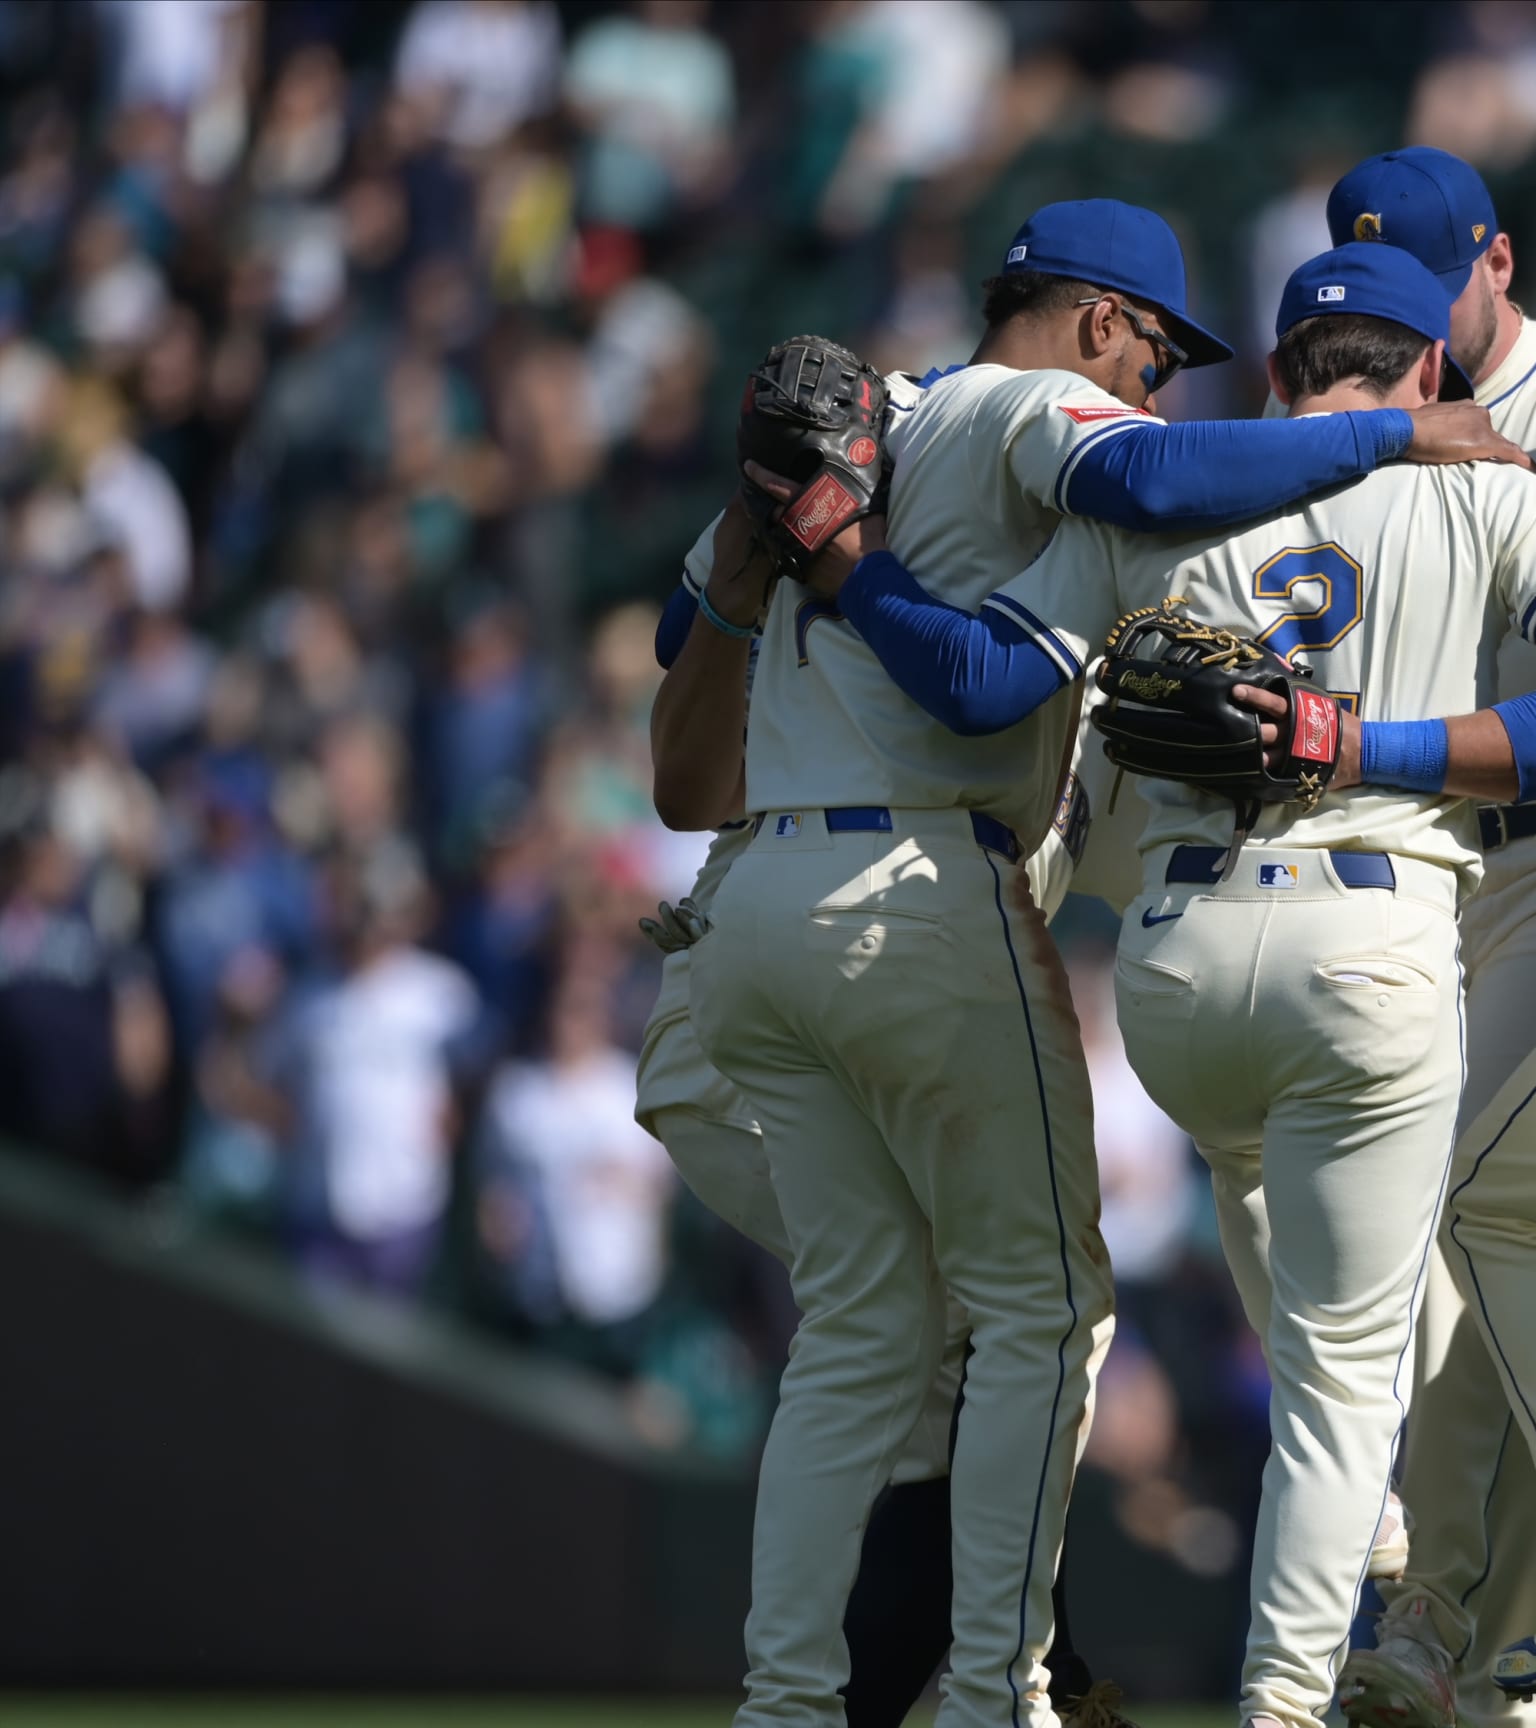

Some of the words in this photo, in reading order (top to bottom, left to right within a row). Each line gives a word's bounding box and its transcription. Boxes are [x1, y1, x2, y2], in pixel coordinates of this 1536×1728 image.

[797, 486, 837, 537] Rawlings
[1252, 541, 1363, 716] 2
[1119, 669, 1183, 698] Rawlings
